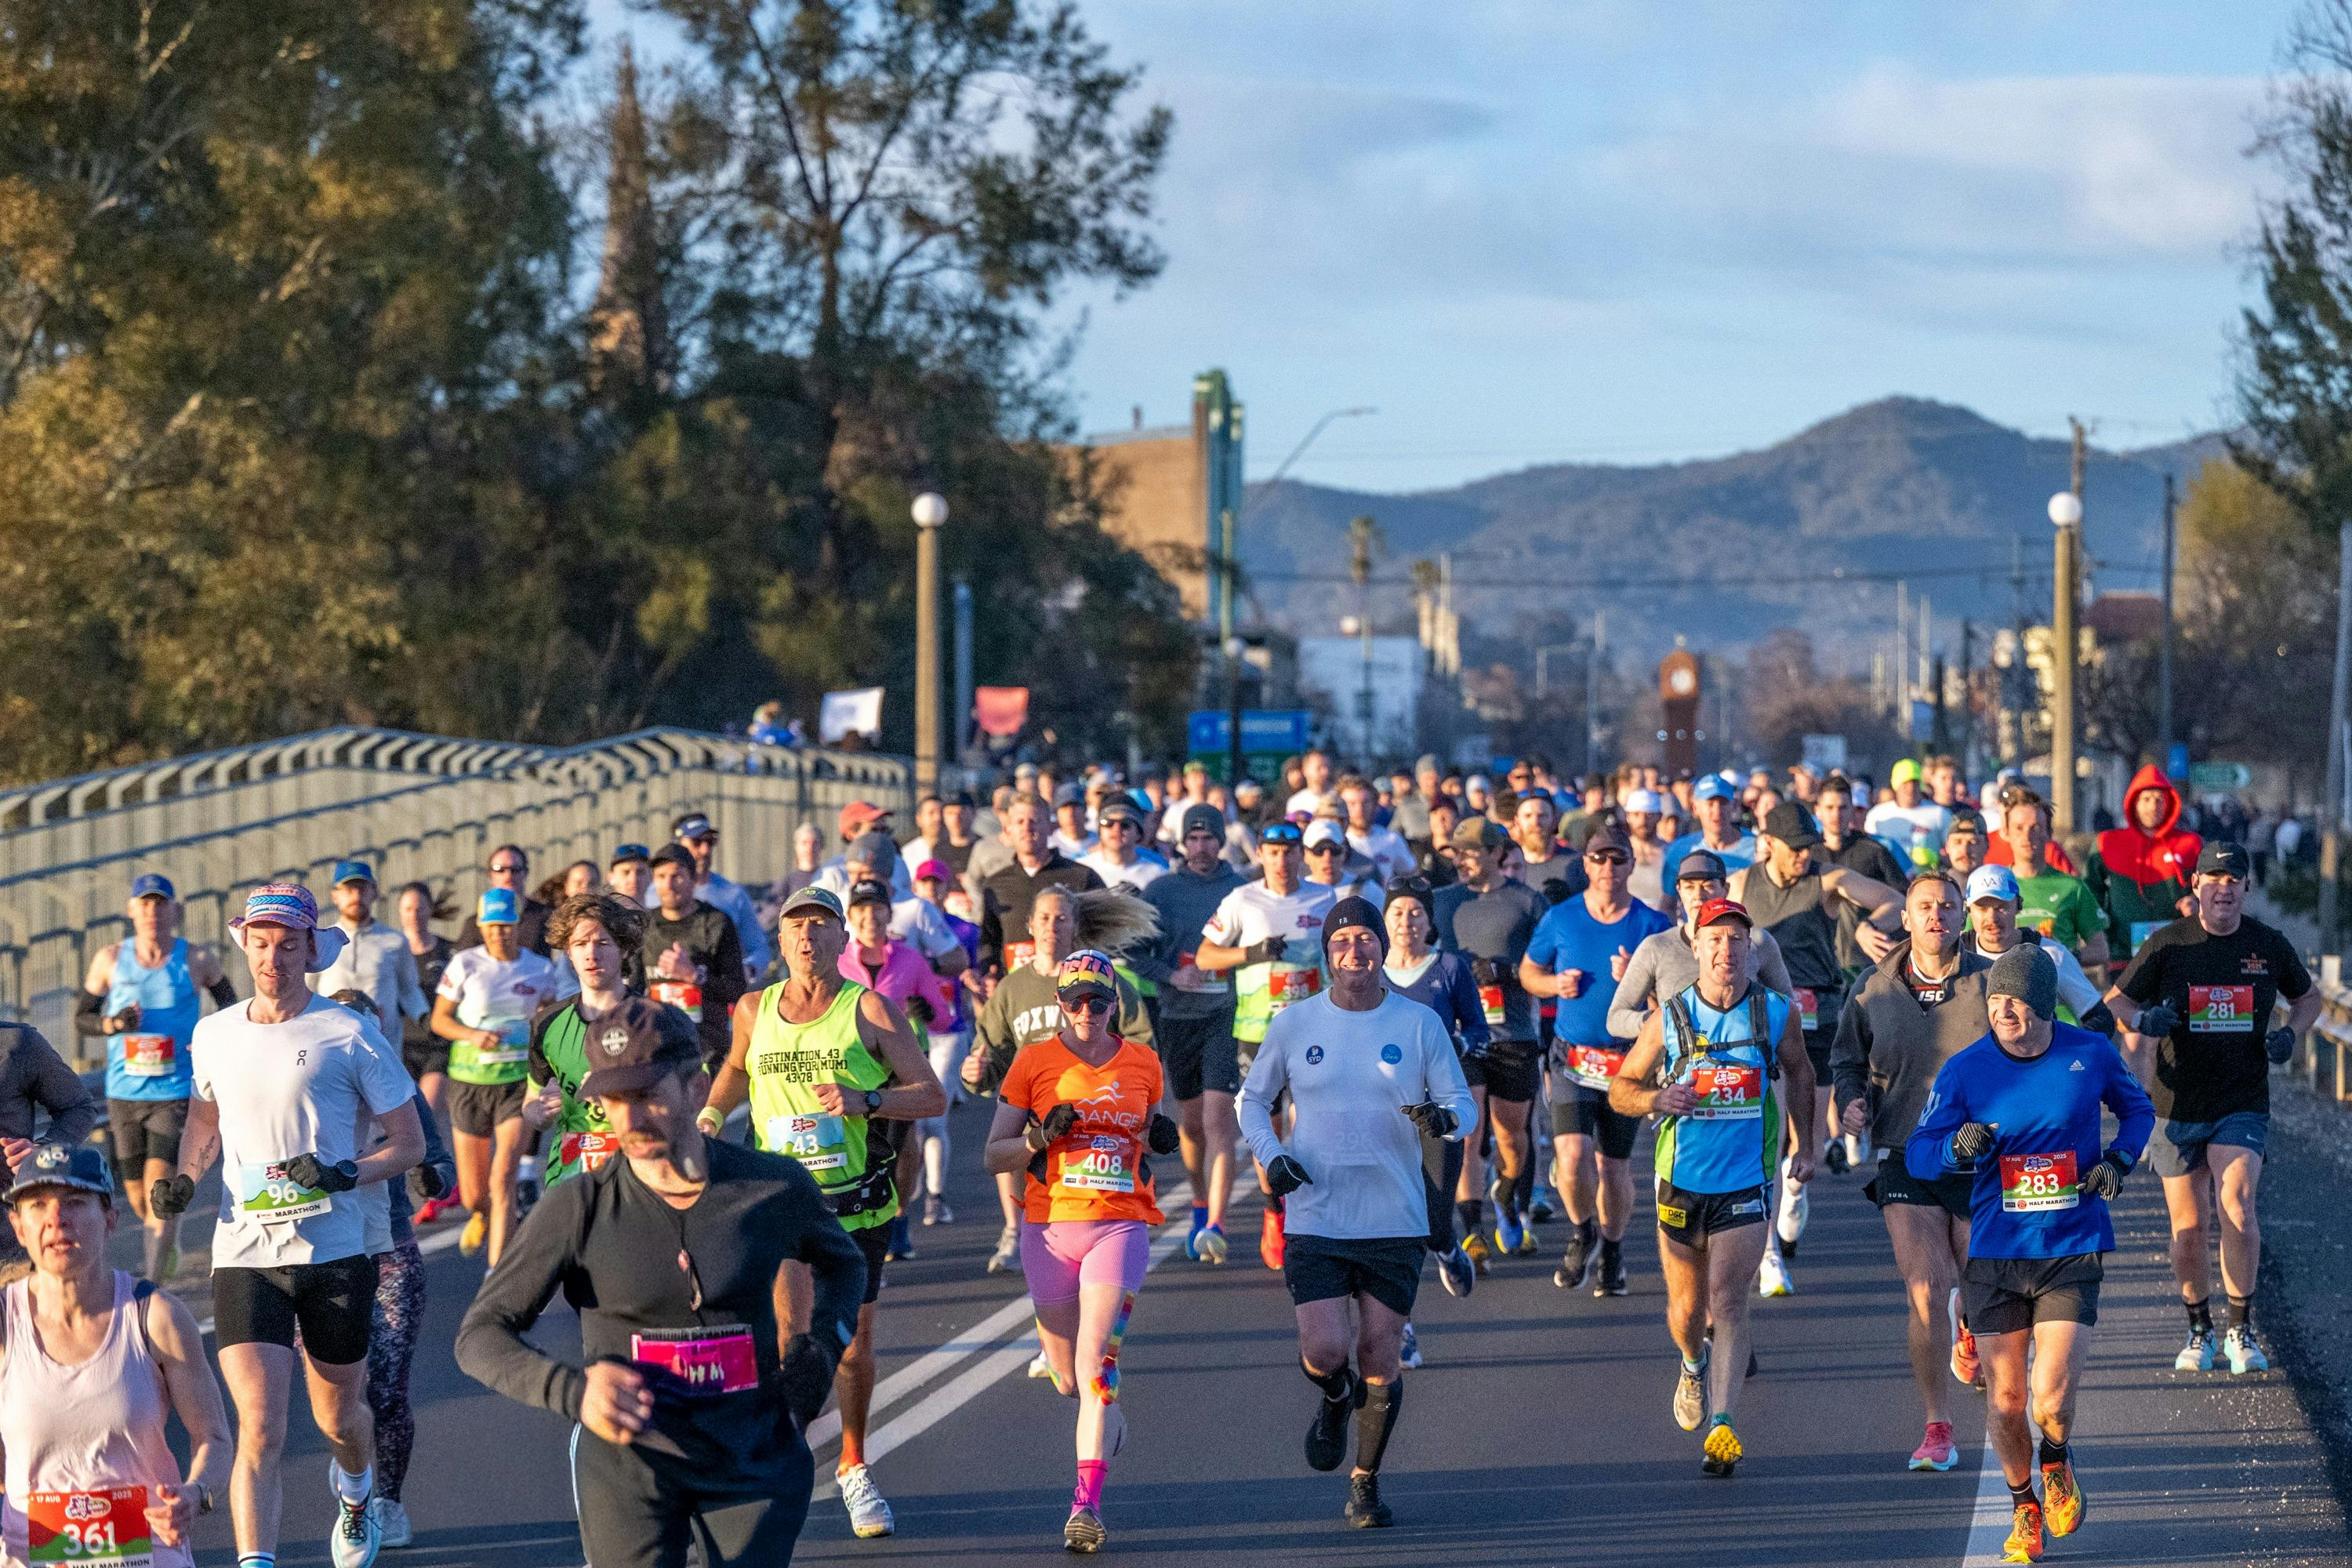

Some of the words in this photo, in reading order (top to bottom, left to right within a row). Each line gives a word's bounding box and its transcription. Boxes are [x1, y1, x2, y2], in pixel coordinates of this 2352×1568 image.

[2208, 1002, 2234, 1019] 281
[1578, 1060, 1608, 1080] 252
[1710, 1086, 1746, 1105] 234
[792, 1134, 819, 1156] 43
[1082, 1152, 1123, 1175] 408
[267, 1180, 299, 1206] 96
[2020, 1173, 2060, 1196] 283
[274, 1203, 321, 1218] MARATHON
[62, 1521, 116, 1556] 361
[99, 1559, 150, 1568] MARATHON
